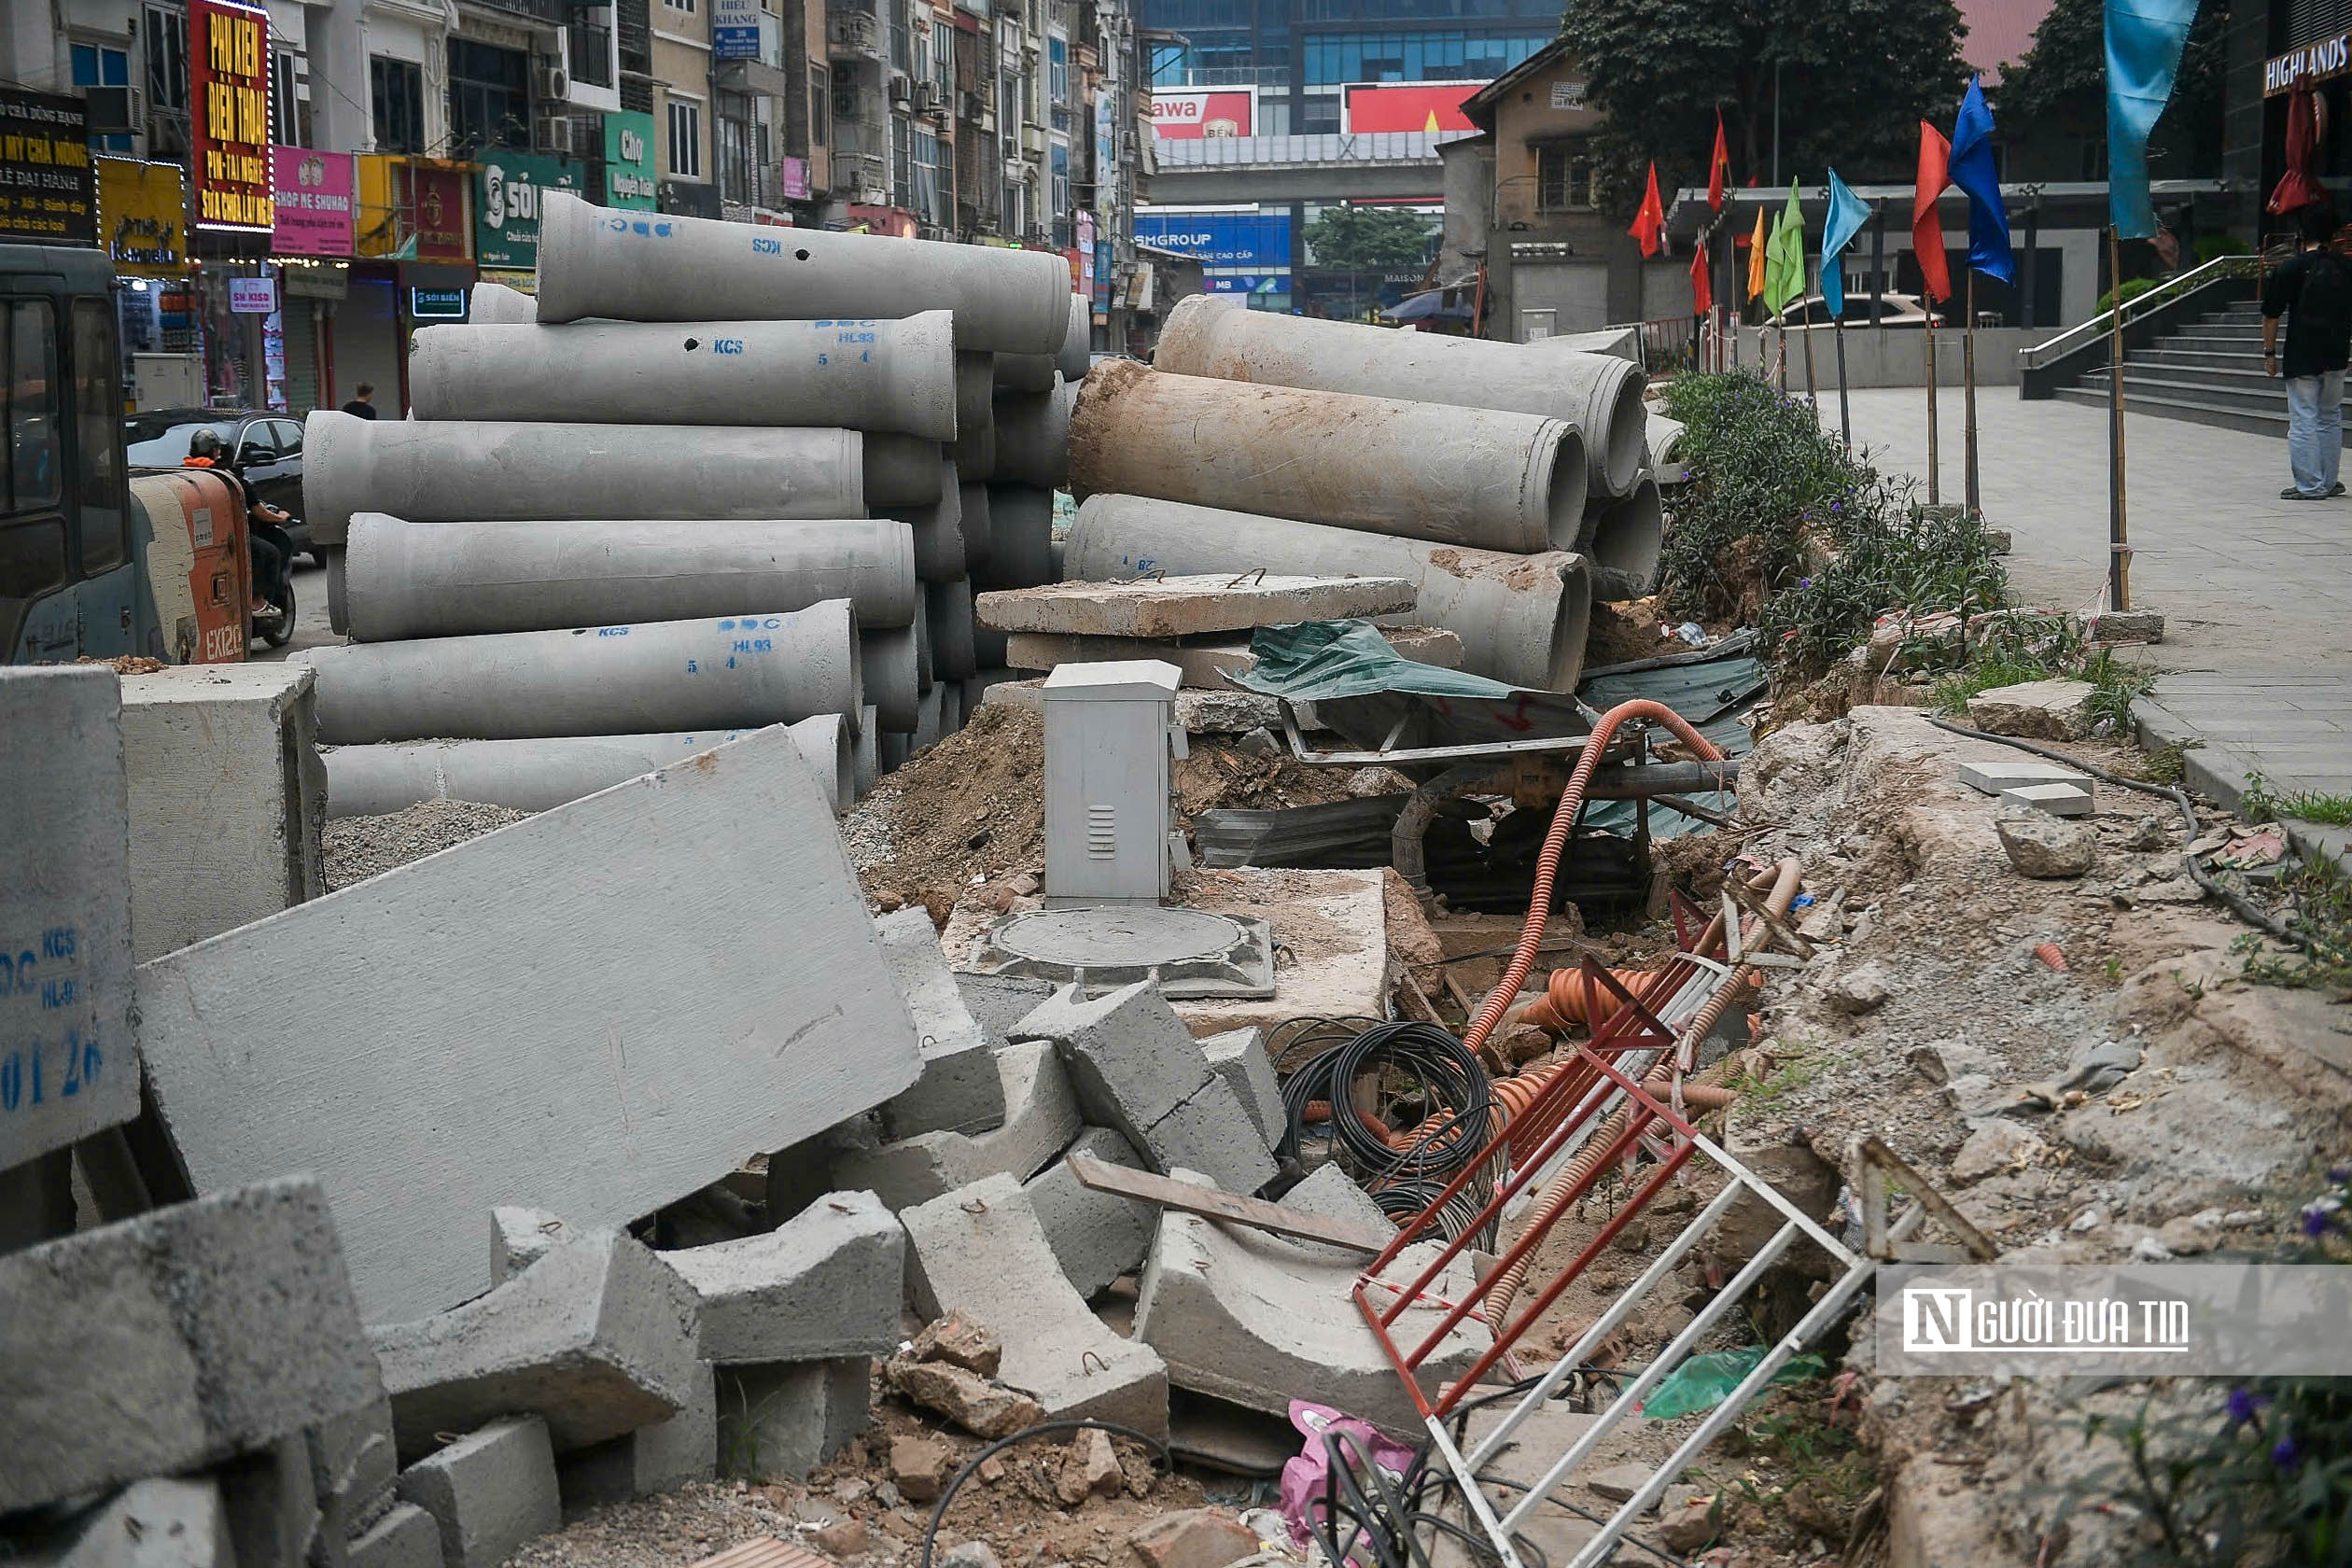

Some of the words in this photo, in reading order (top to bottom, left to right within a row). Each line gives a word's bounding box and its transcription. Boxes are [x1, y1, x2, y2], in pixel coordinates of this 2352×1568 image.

[715, 14, 757, 24] KHANG
[2266, 35, 2347, 91] HIGHLANDS
[752, 238, 780, 254] KCS
[1384, 273, 1425, 283] MAISON
[1216, 281, 1232, 289] MB
[714, 339, 743, 354] KCS
[819, 353, 829, 365] 5
[598, 627, 629, 637] KCS
[734, 639, 772, 654] HL93
